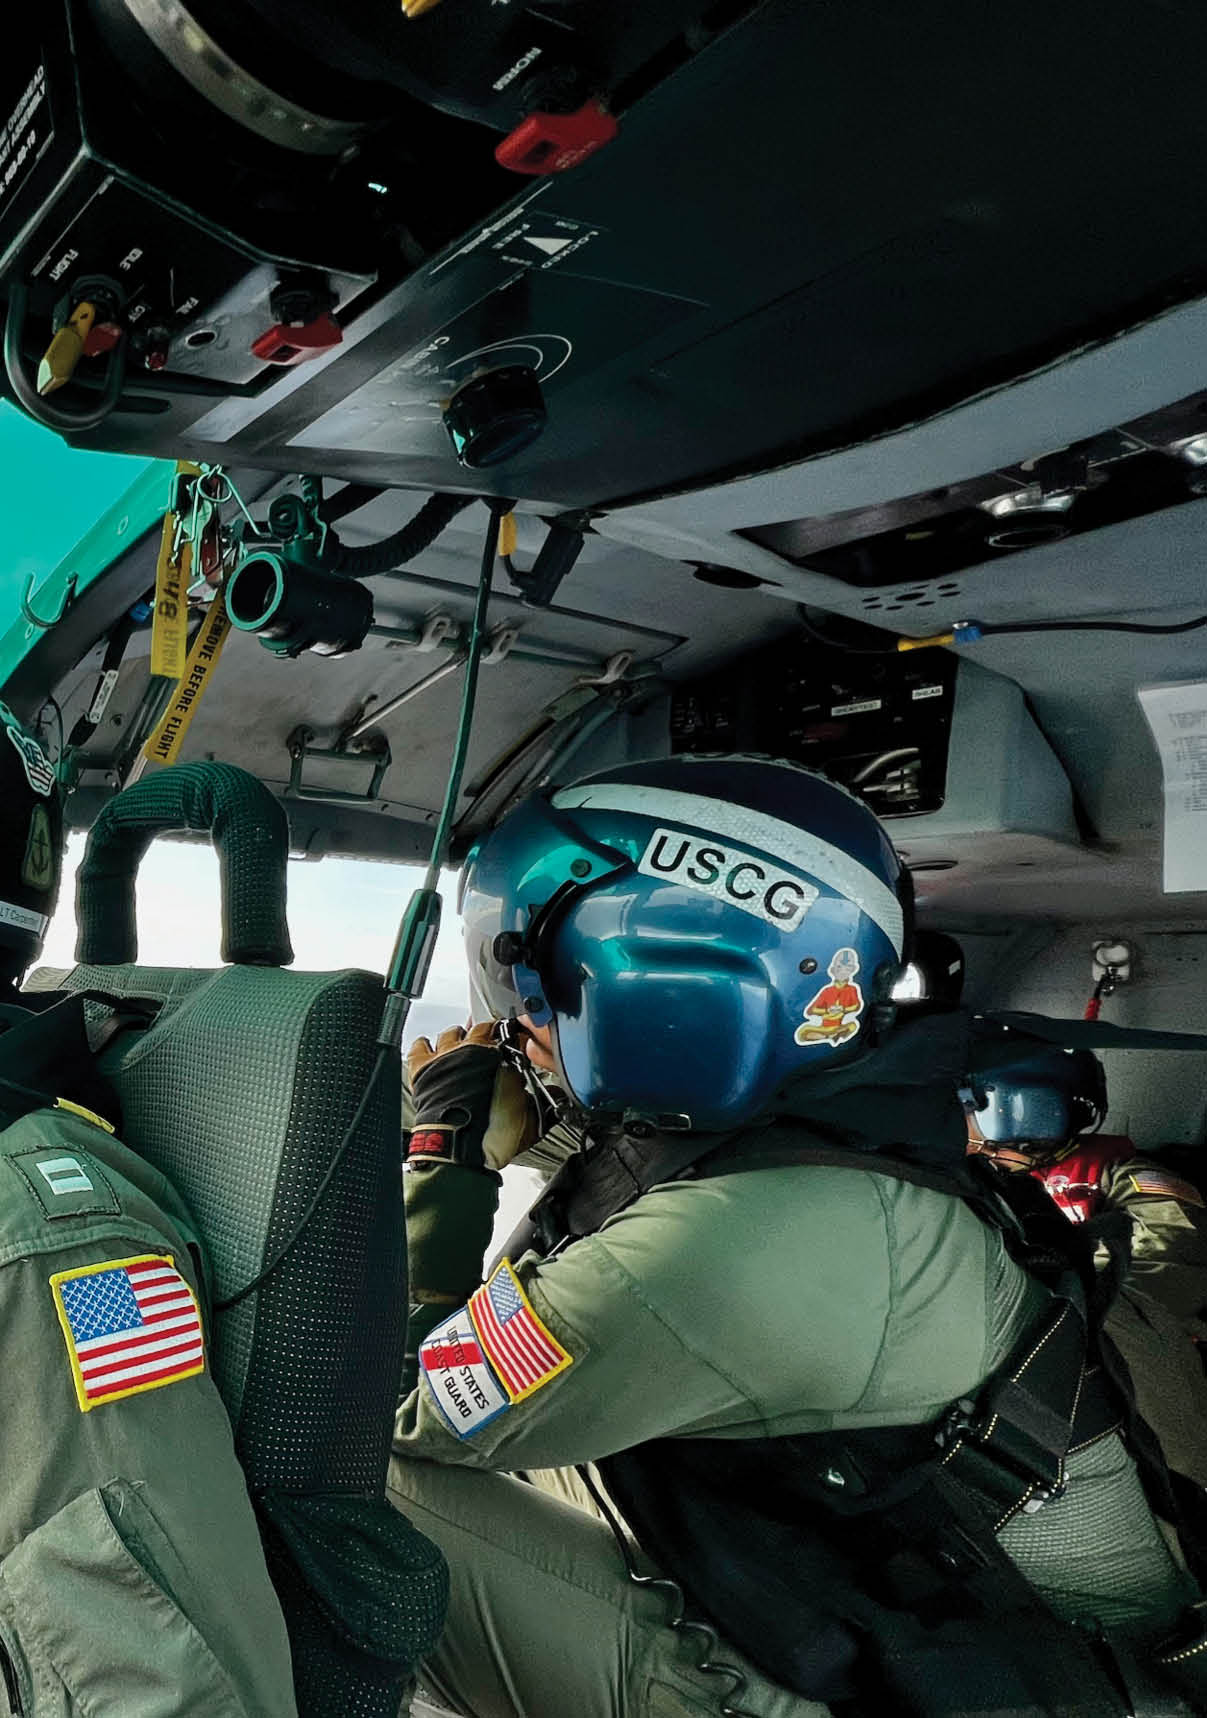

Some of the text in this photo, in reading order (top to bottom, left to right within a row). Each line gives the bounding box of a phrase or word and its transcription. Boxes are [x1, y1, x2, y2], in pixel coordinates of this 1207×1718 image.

[49, 249, 79, 281] FLIGHT
[120, 248, 143, 271] IDLE
[175, 664, 207, 713] BEFORE
[155, 716, 183, 759] FLIGHT
[649, 834, 805, 922] USCG
[432, 1339, 472, 1418] COAST GUARD
[447, 1325, 490, 1409] UNITED STATES
